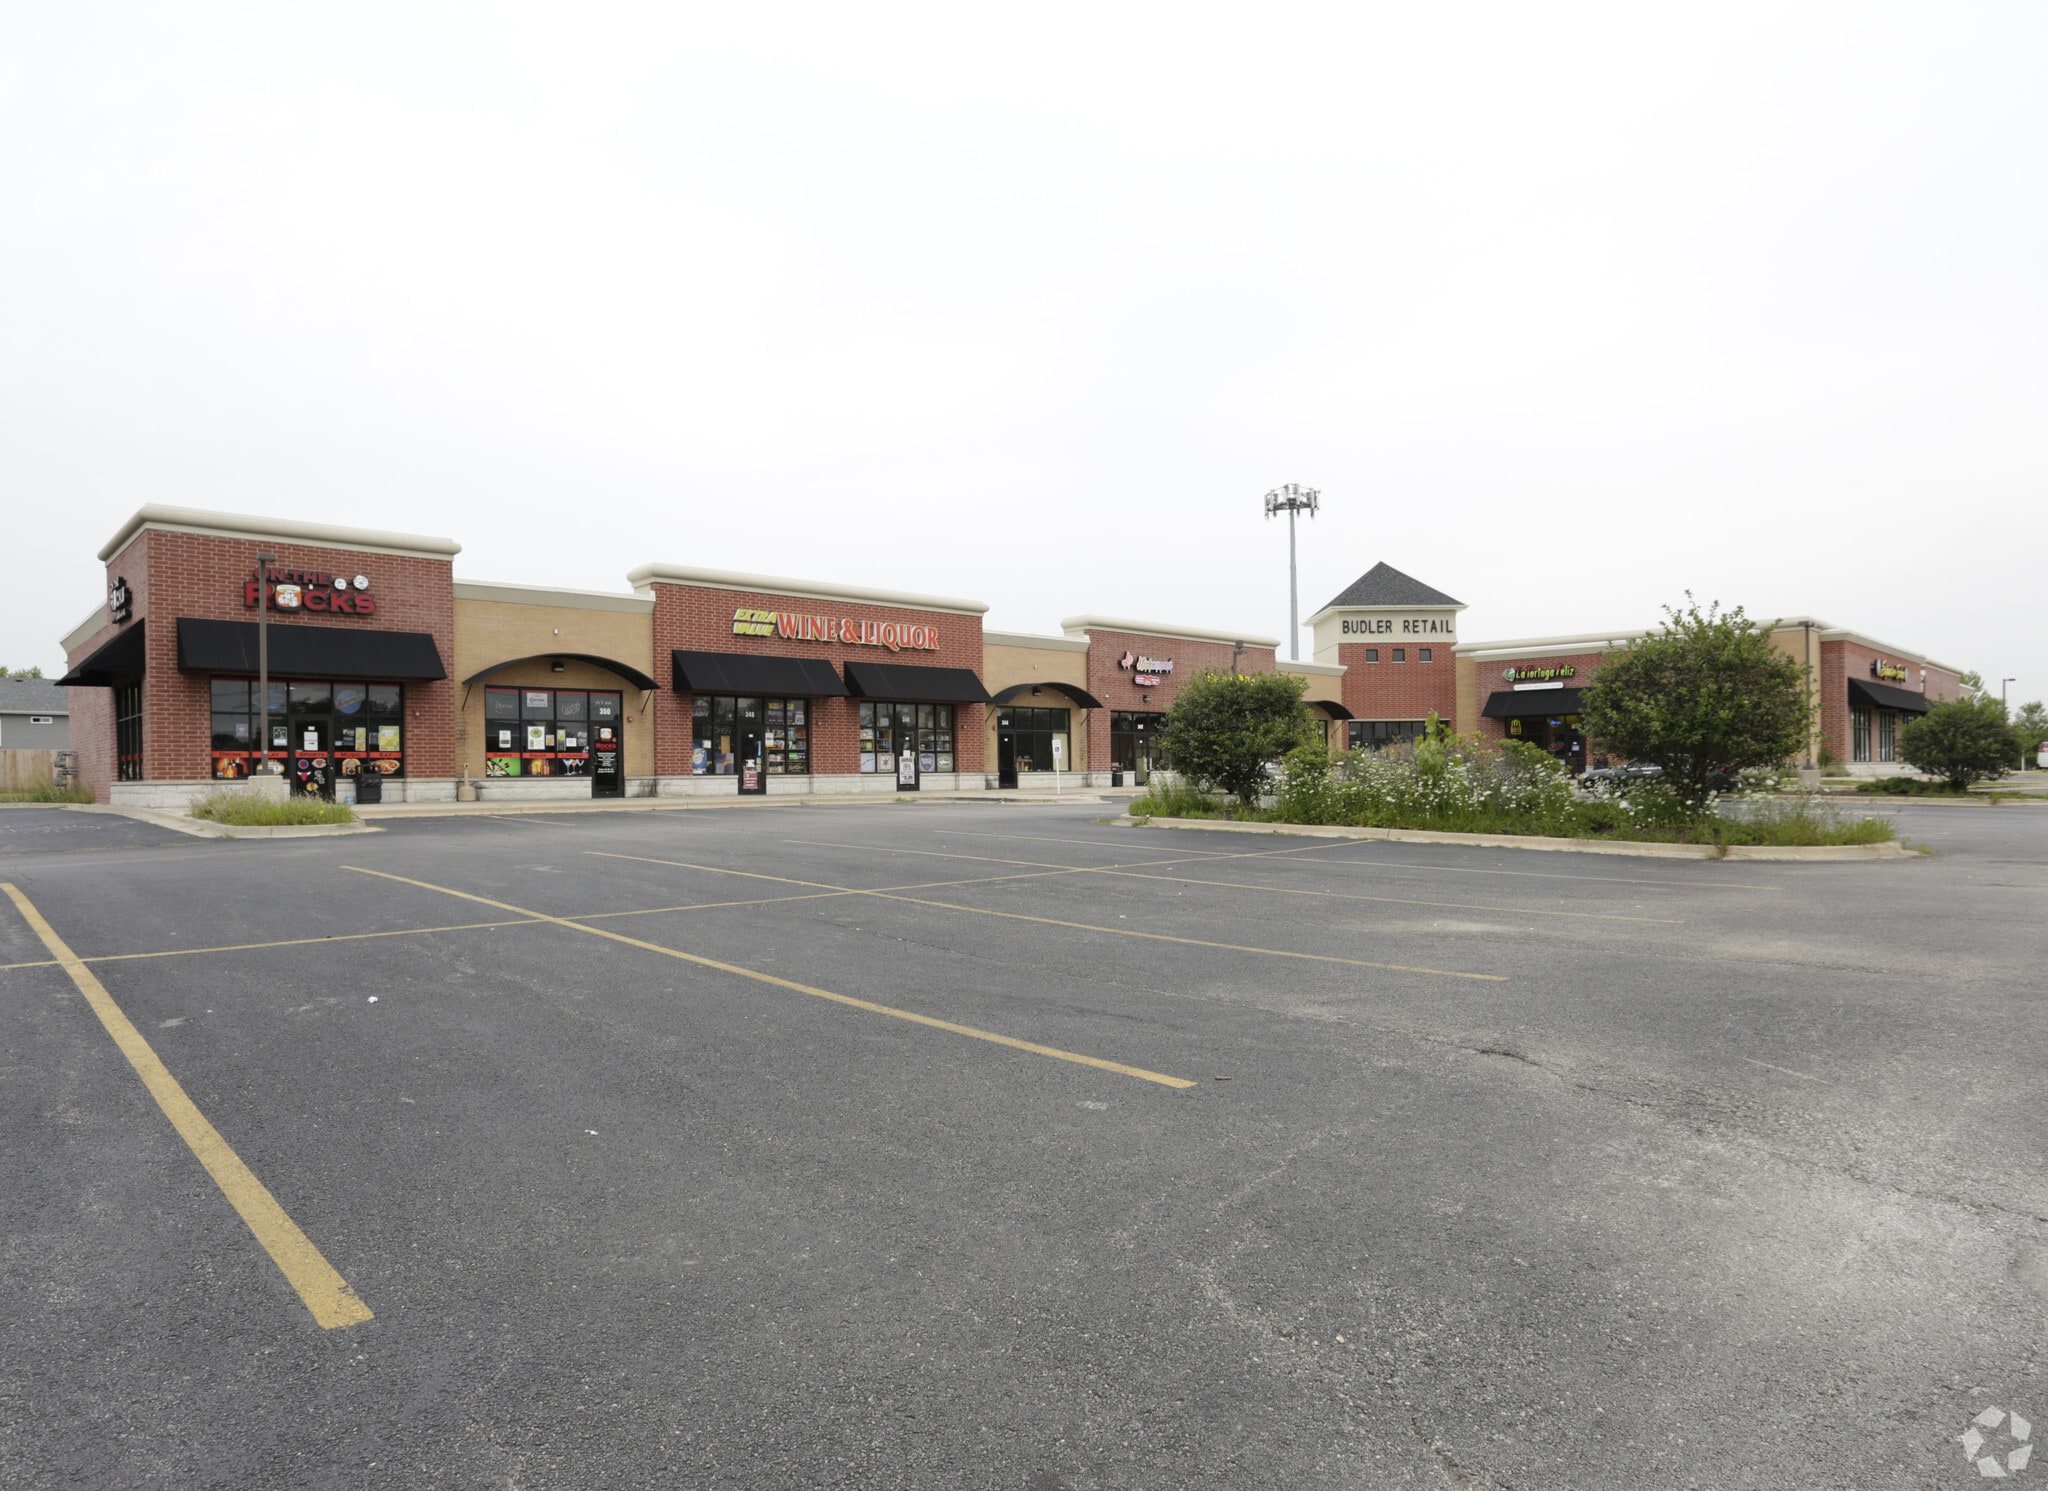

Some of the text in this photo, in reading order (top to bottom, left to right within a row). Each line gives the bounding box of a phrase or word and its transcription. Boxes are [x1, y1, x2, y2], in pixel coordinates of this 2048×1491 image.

[288, 570, 332, 586] THE
[243, 581, 377, 614] ROCKS
[733, 608, 777, 623] EXTRA
[732, 622, 775, 636] VALUE
[777, 611, 940, 651] WINE & LIQUOR
[1342, 619, 1454, 634] BUDLER RETAIL
[599, 707, 611, 716] 350
